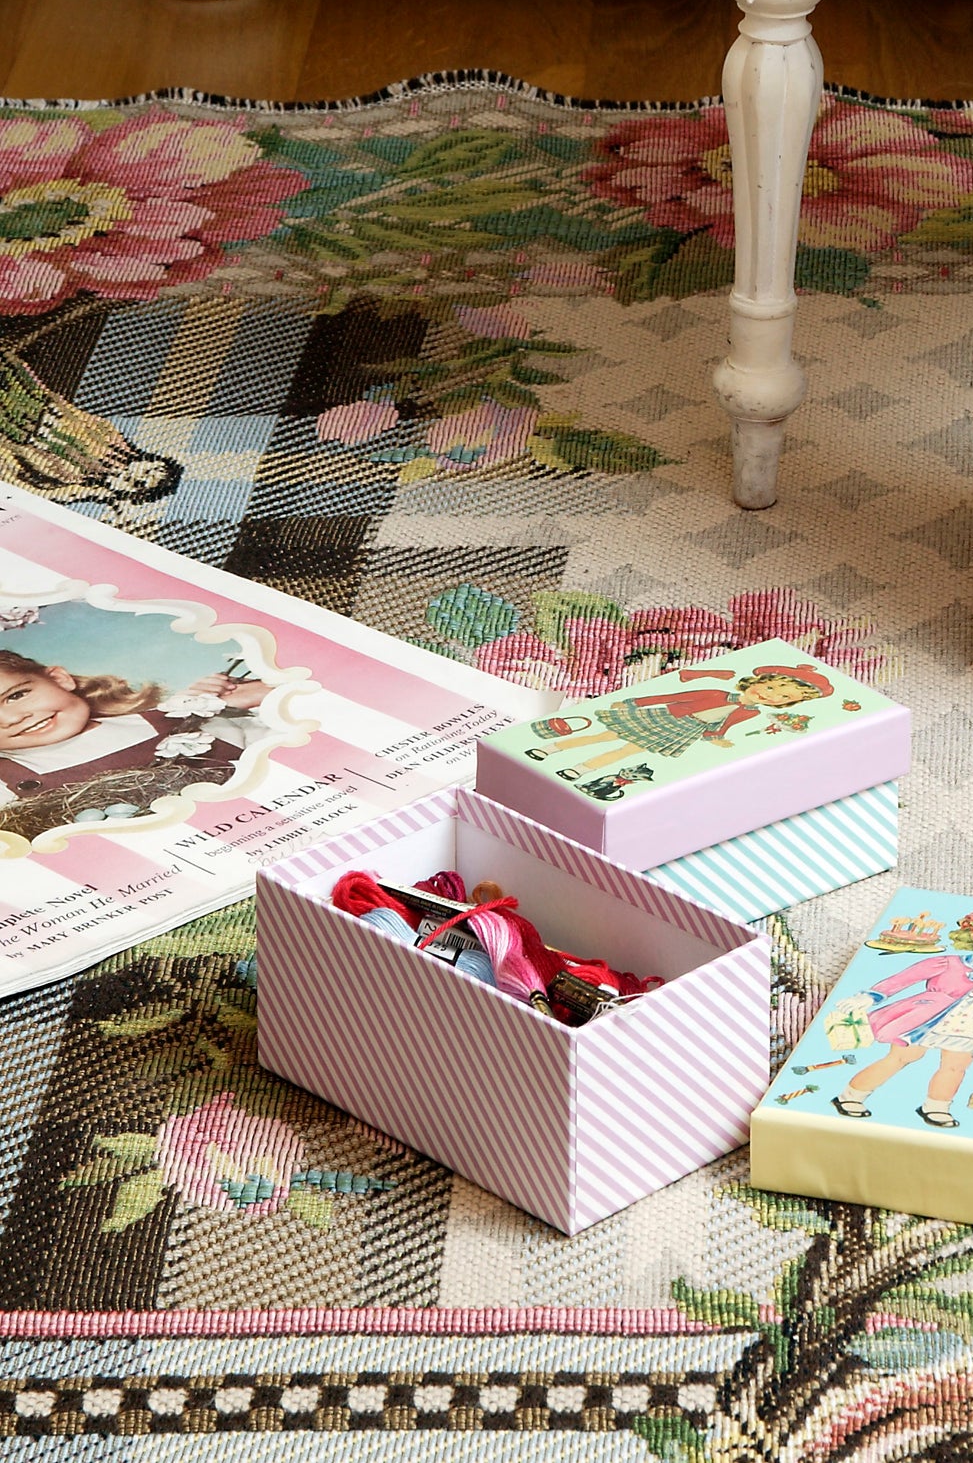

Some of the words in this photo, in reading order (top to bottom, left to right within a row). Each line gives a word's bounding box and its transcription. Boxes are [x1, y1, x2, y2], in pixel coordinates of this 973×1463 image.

[374, 731, 432, 759] CHESTER
[432, 703, 486, 733] BOWLES
[385, 761, 422, 781] DEAN
[422, 715, 516, 764] GILDERSLEEVE
[395, 752, 411, 763] on
[411, 727, 466, 755] Rationing
[461, 709, 498, 731] Today
[446, 755, 461, 766] on
[174, 821, 234, 850] WILD
[234, 771, 343, 824] CALENDAR
[204, 828, 267, 858] beginning
[265, 824, 276, 832] a
[275, 799, 325, 828] sensitive
[326, 784, 359, 805] novel
[245, 846, 265, 859] by
[264, 823, 313, 852] LIBBIE
[311, 802, 360, 828] BLOCK
[0, 935, 21, 947] he
[20, 907, 88, 936] Woman
[89, 895, 116, 910] He
[117, 863, 183, 899] Married
[5, 951, 25, 959] by
[27, 929, 70, 951] MARY
[71, 903, 138, 933] BRINKER
[138, 887, 174, 906] POST
[46, 883, 99, 909] Novel
